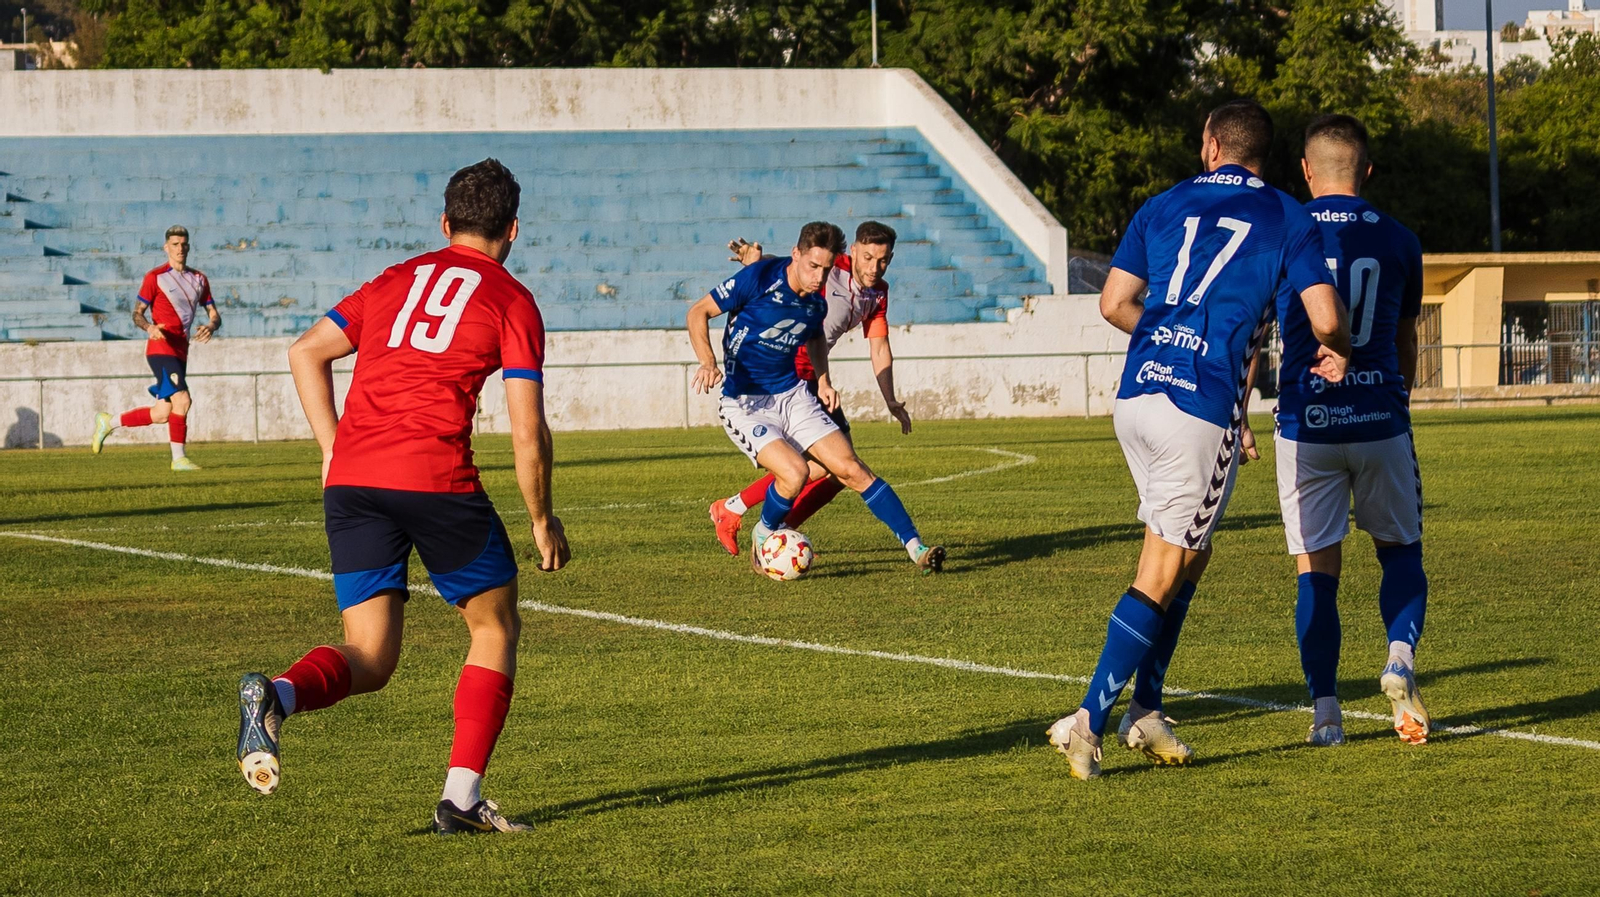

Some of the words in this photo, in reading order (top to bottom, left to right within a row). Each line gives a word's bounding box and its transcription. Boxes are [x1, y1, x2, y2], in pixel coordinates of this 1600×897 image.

[1193, 172, 1243, 186] indeso
[1310, 209, 1357, 222] ndeso
[1165, 216, 1252, 305] 17
[387, 263, 482, 353] 19
[775, 332, 799, 346] Air
[1149, 360, 1173, 375] High
[1147, 370, 1198, 392] ProNtrition
[1330, 404, 1354, 416] High
[1331, 411, 1392, 426] ProNutrition
